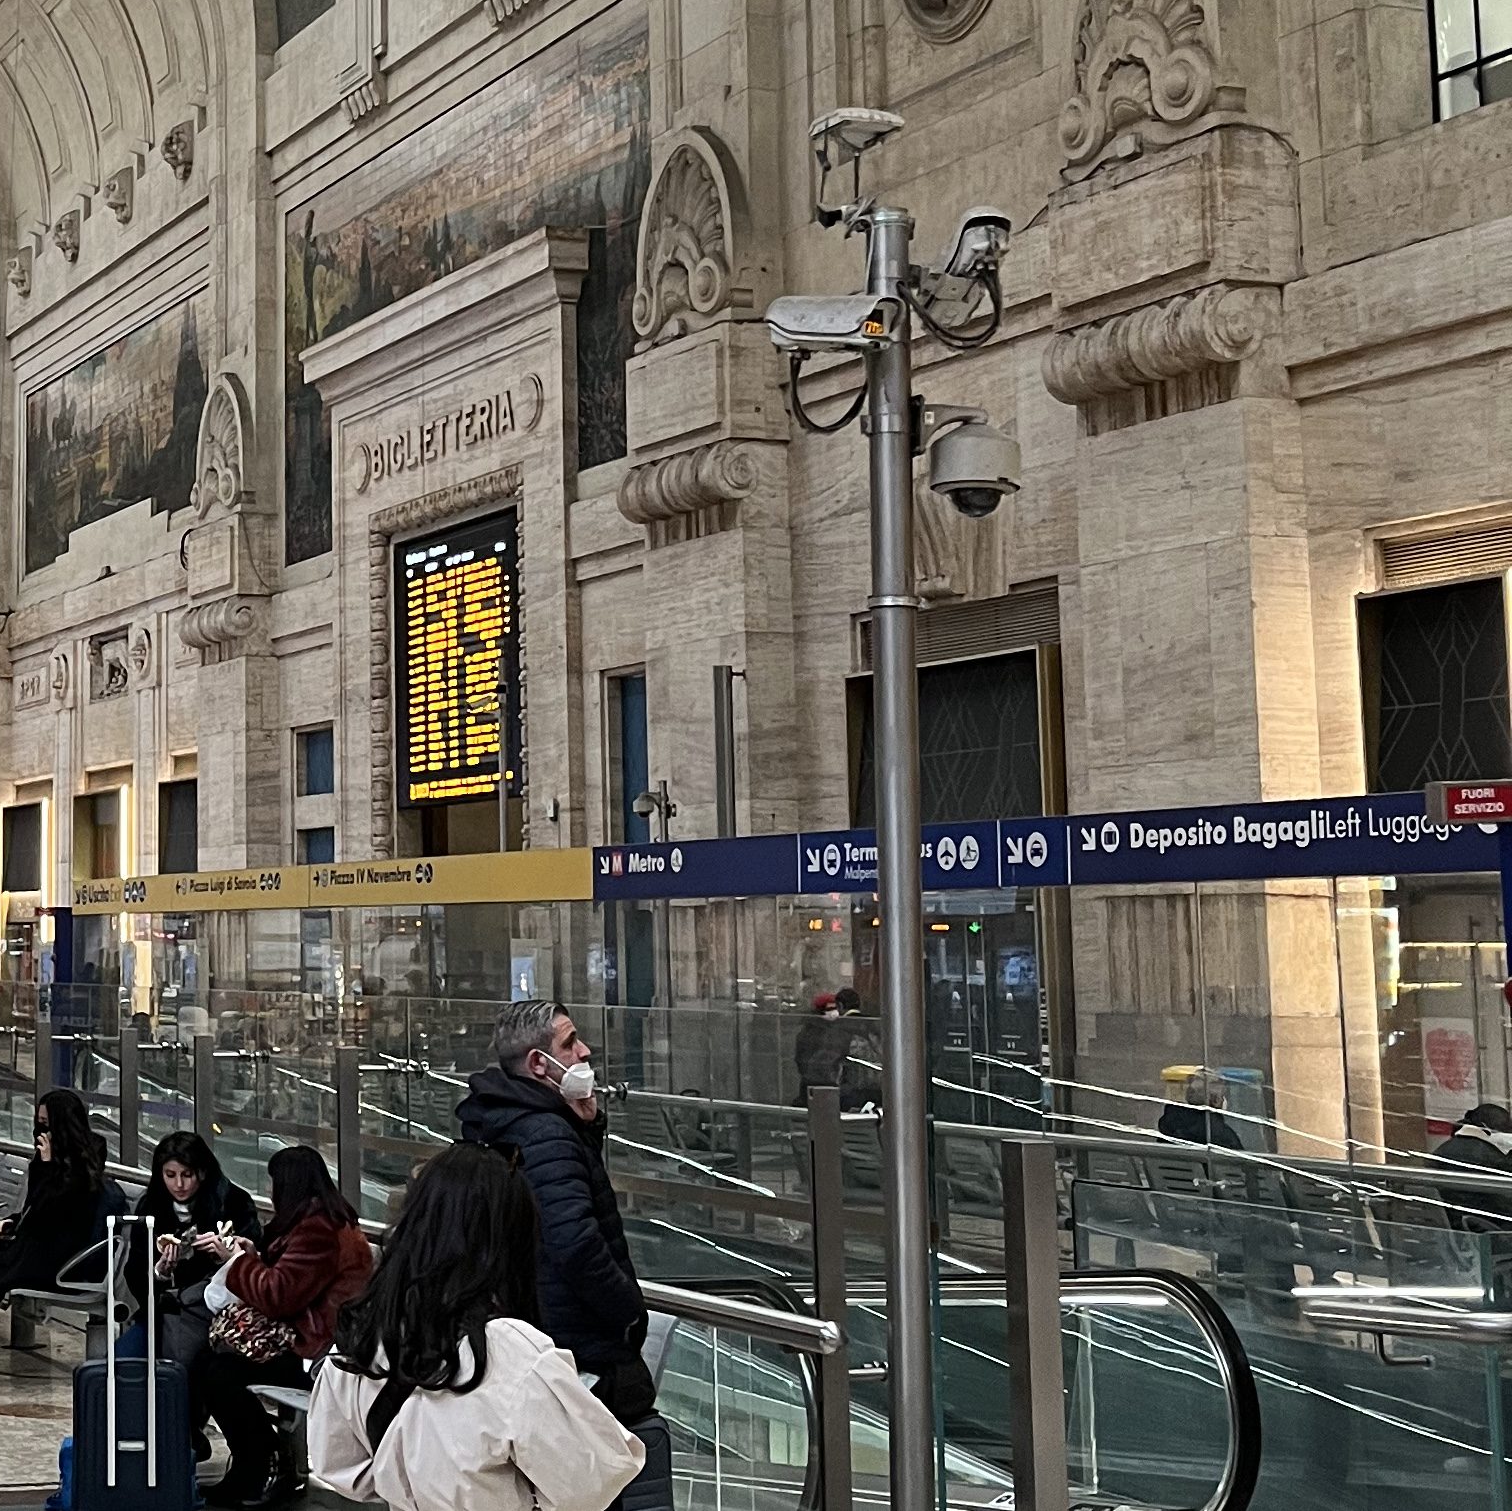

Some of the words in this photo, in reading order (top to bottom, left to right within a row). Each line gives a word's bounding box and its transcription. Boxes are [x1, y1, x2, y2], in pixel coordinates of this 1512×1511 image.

[371, 390, 515, 481] BIGLIETTERIA
[1461, 788, 1495, 800] FUORI
[1454, 802, 1505, 814] SERVIZIO
[1129, 818, 1227, 854] Deposito
[843, 842, 879, 862] Term
[628, 852, 665, 873] Metro
[356, 868, 366, 884] IV
[367, 866, 412, 884] Novembre
